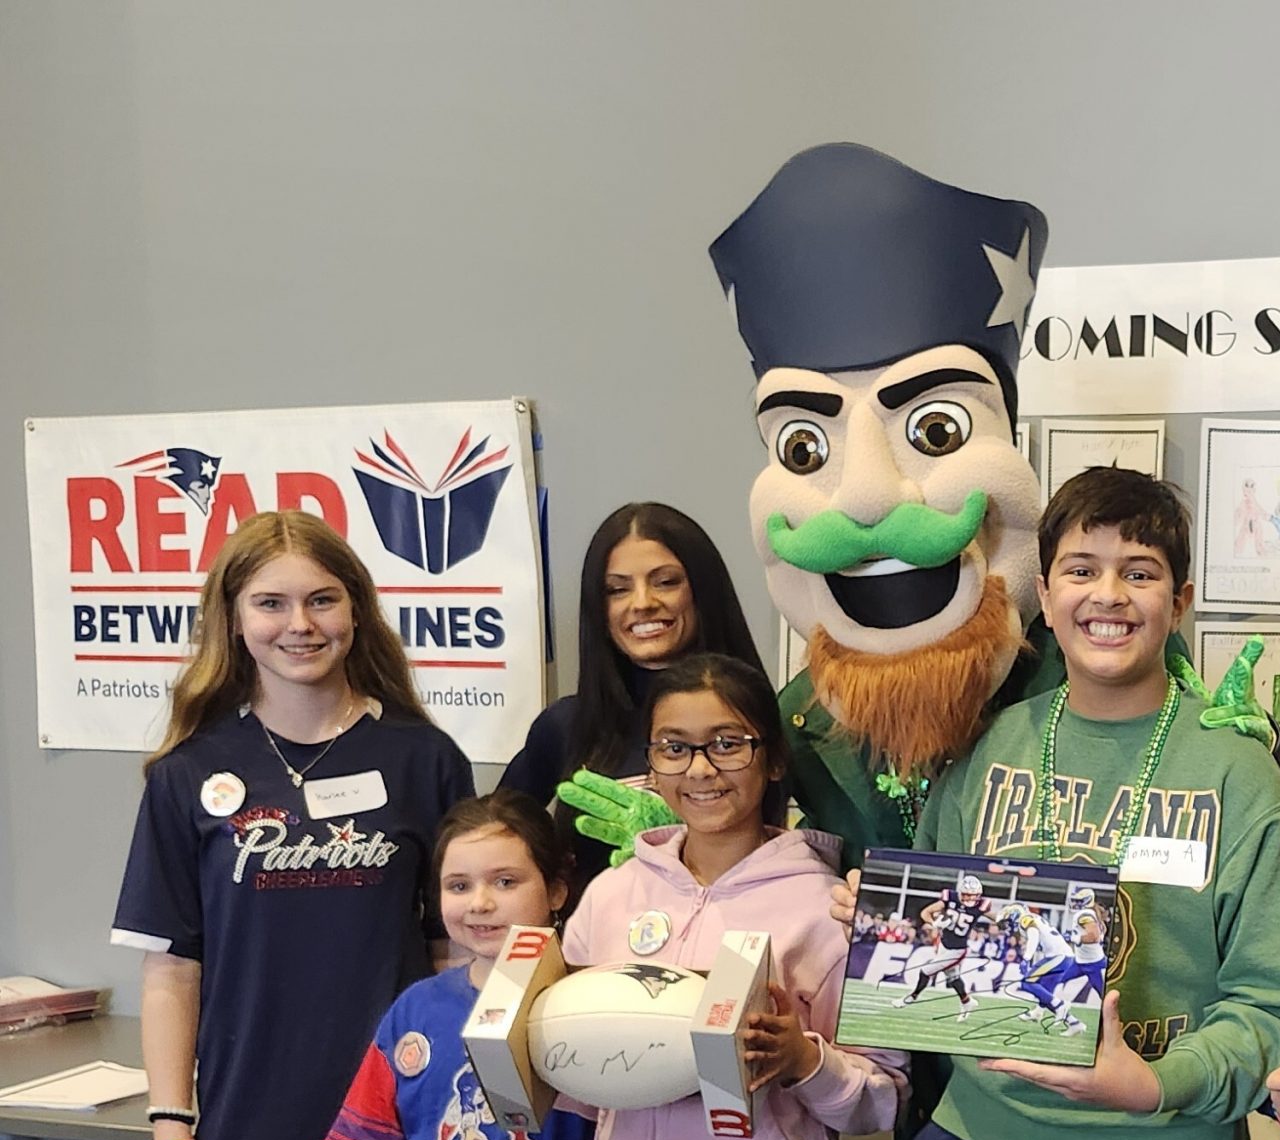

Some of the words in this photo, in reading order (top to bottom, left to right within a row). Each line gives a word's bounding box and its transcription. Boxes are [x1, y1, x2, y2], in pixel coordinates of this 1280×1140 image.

[1020, 310, 1237, 361] OMING
[399, 606, 506, 649] INES
[76, 678, 88, 696] A
[91, 679, 160, 698] Patriots
[420, 686, 505, 707] undation
[232, 818, 399, 884] Patriots
[971, 763, 1221, 893] IRELAND
